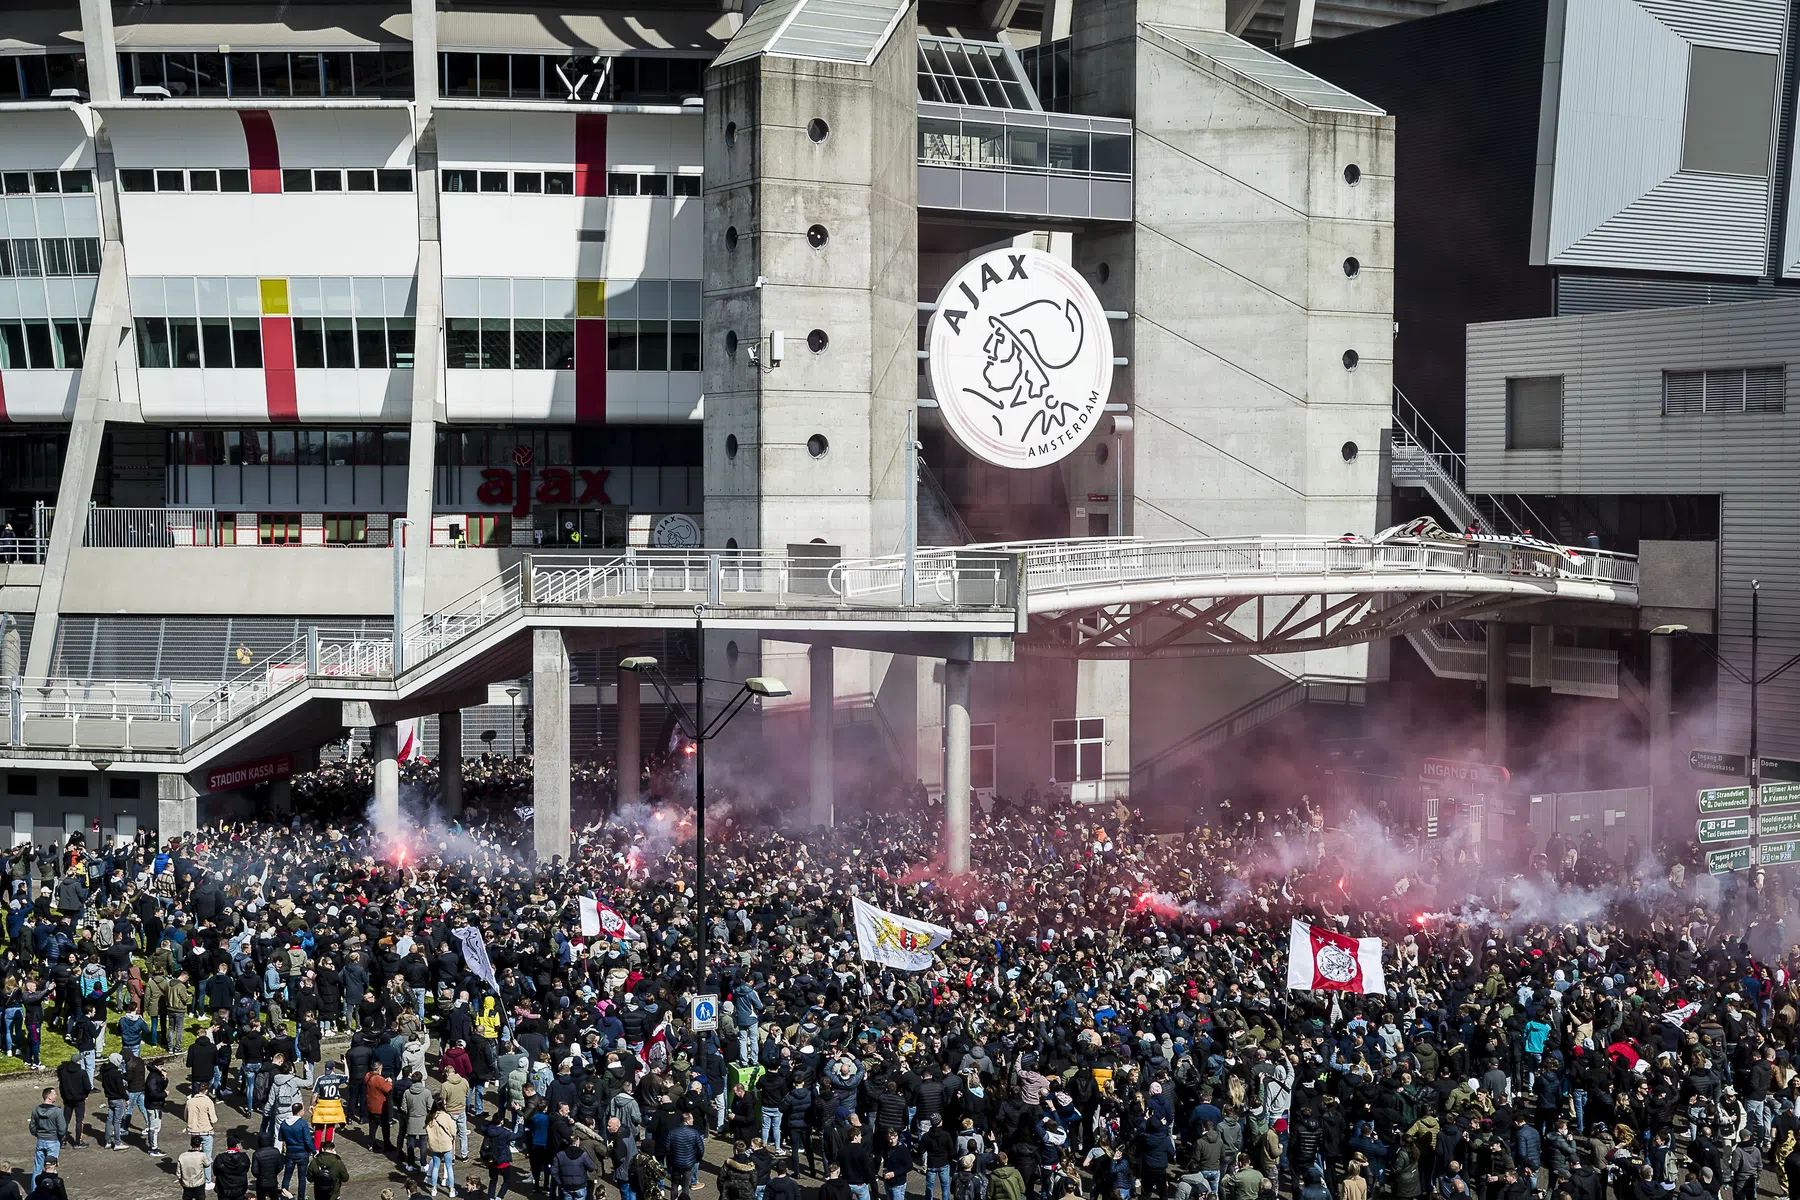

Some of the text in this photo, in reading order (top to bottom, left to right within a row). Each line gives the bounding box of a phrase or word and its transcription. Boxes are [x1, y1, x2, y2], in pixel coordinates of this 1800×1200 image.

[943, 255, 1028, 336] AJAX
[1028, 390, 1100, 457] AMSTERDAM
[477, 468, 612, 517] ajax
[657, 516, 676, 535] AJAX
[1697, 753, 1717, 762] Ingang
[1424, 763, 1467, 779] INGANG
[1470, 769, 1478, 780] D
[1697, 763, 1735, 772] Stadionkassa
[210, 764, 274, 787] STADION KASSA
[1768, 785, 1787, 794] Bijlmer
[1716, 790, 1745, 799] Strandvliet
[1713, 799, 1748, 808] Duivendrecht
[1761, 815, 1793, 823] Hoofdingang
[1717, 829, 1748, 837] Evenementen
[1761, 825, 1778, 833] Ingang
[1715, 853, 1730, 861] Ingang
[323, 1085, 336, 1098] 10
